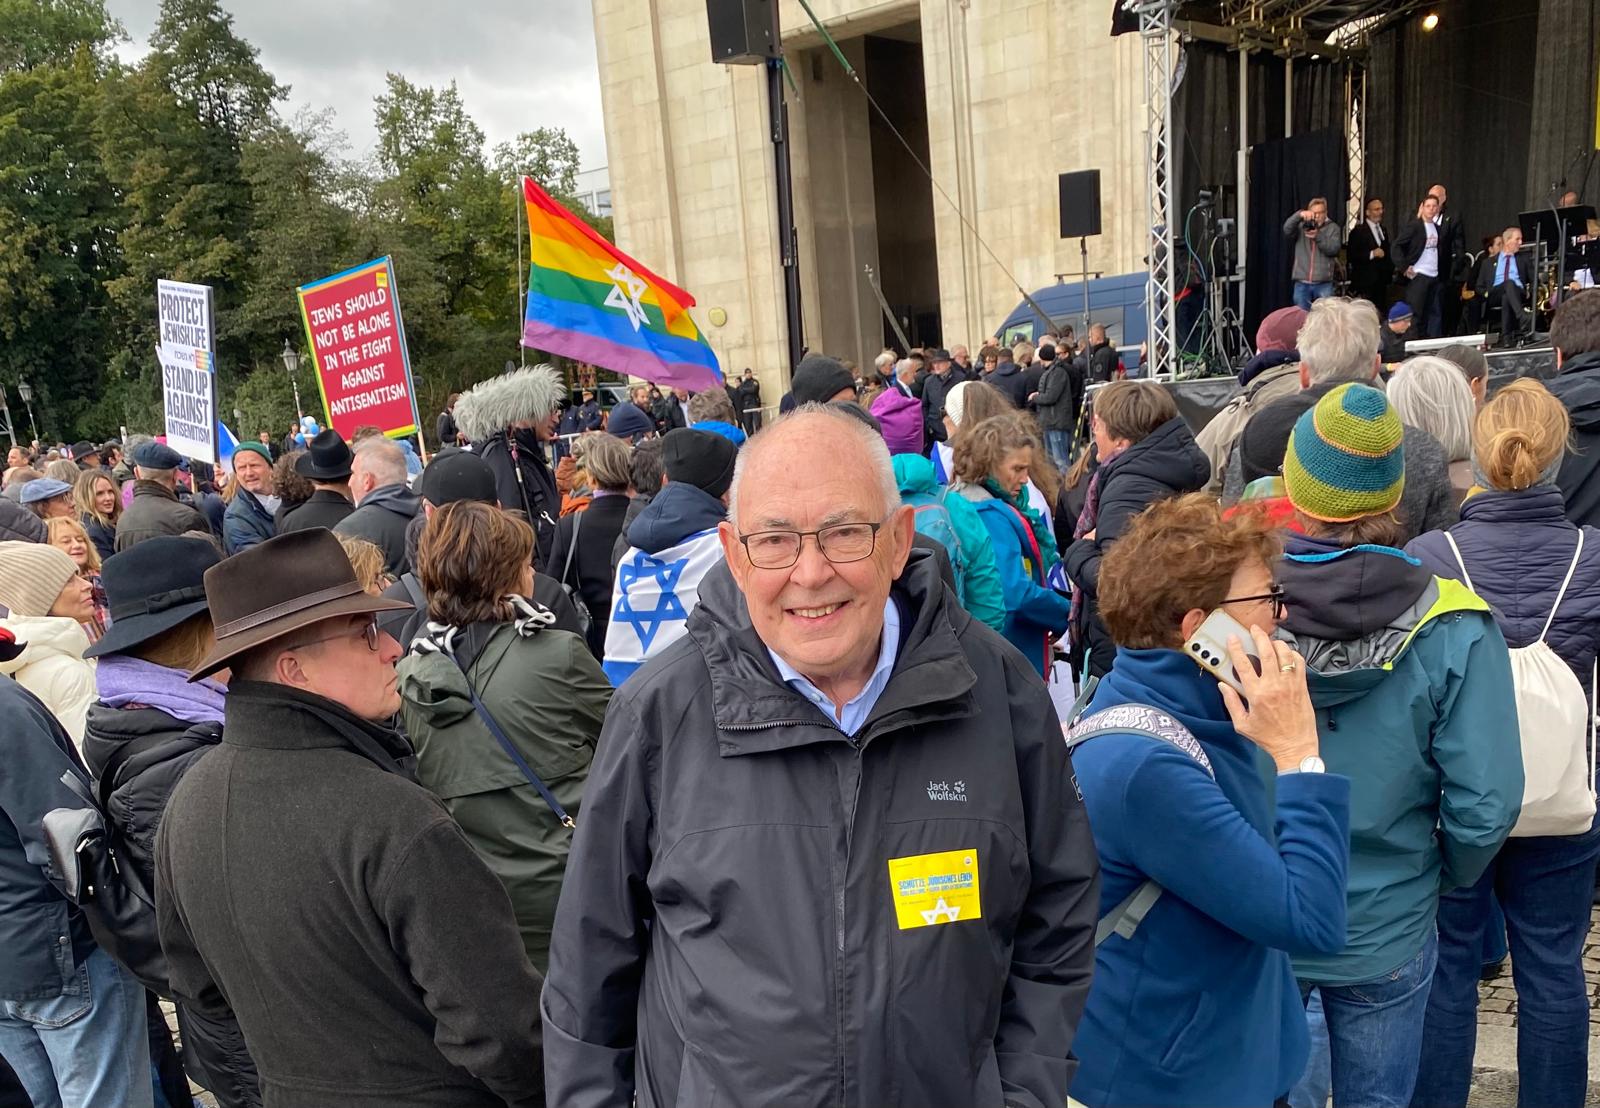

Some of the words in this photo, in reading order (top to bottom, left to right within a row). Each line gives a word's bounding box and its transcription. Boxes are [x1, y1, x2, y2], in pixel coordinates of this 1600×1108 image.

[160, 292, 205, 327] PROTECT
[311, 302, 342, 326] JEWS
[345, 288, 386, 315] SHOULD
[162, 322, 191, 346] JEWISH
[191, 325, 206, 349] LIFE
[315, 328, 339, 349] NOT
[341, 323, 356, 341] BE
[357, 311, 391, 336] ALONE
[323, 352, 338, 371] IN
[339, 346, 360, 366] THE
[361, 336, 392, 360] FIGHT
[165, 364, 194, 394] STAND
[195, 370, 208, 397] UP
[341, 363, 385, 390] AGAINST
[167, 390, 208, 426] AGAINST
[330, 382, 406, 416] ANTISEMITISM
[168, 418, 211, 445] ANTISEMITISM
[927, 780, 950, 791] Jack
[928, 790, 967, 802] Wolfskin
